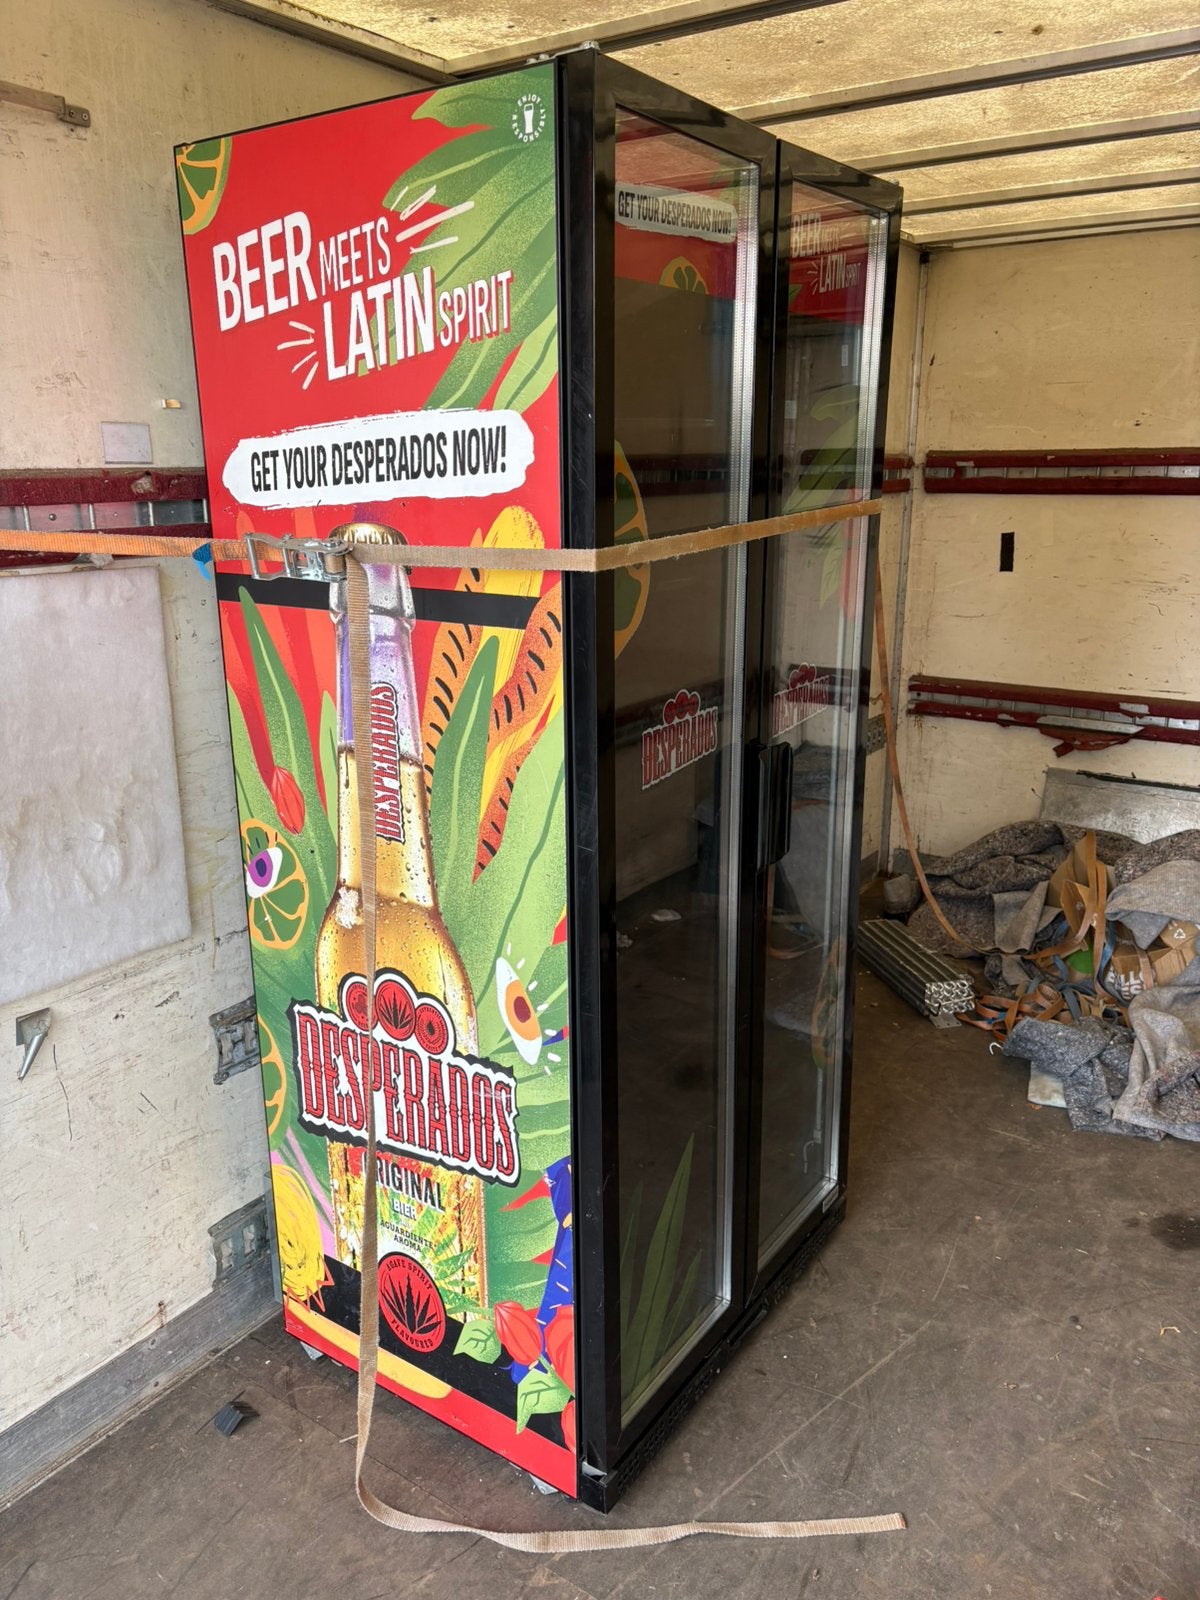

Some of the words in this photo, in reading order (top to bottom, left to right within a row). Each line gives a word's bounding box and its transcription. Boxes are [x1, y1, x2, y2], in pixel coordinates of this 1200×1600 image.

[517, 93, 541, 107] ENJOY
[512, 108, 546, 143] RESPONSIBLY
[618, 190, 636, 218] GET
[636, 194, 660, 223] YOUR
[661, 199, 711, 232] DESPERADOS
[711, 209, 732, 235] NOW!
[791, 212, 821, 258] BEER
[212, 210, 318, 332] BEER
[318, 215, 390, 296] MEETS
[819, 252, 847, 293] LATIN
[323, 265, 436, 382] LATIN
[439, 270, 513, 348] SPIRIT
[250, 450, 282, 493] GET
[282, 446, 328, 490] YOUR
[331, 430, 448, 487] DESPERADOS
[452, 425, 508, 477] NOW!
[642, 708, 718, 788] DESPERADOS
[297, 1013, 516, 1176] DESPERADOS
[362, 1152, 446, 1215] RIGINAL
[392, 1197, 417, 1221] BIER
[393, 1234, 422, 1253] AROMA
[386, 1259, 406, 1272] AGAVE
[408, 1262, 433, 1290] SPIRIT
[391, 1318, 434, 1349] FLAVOURED
